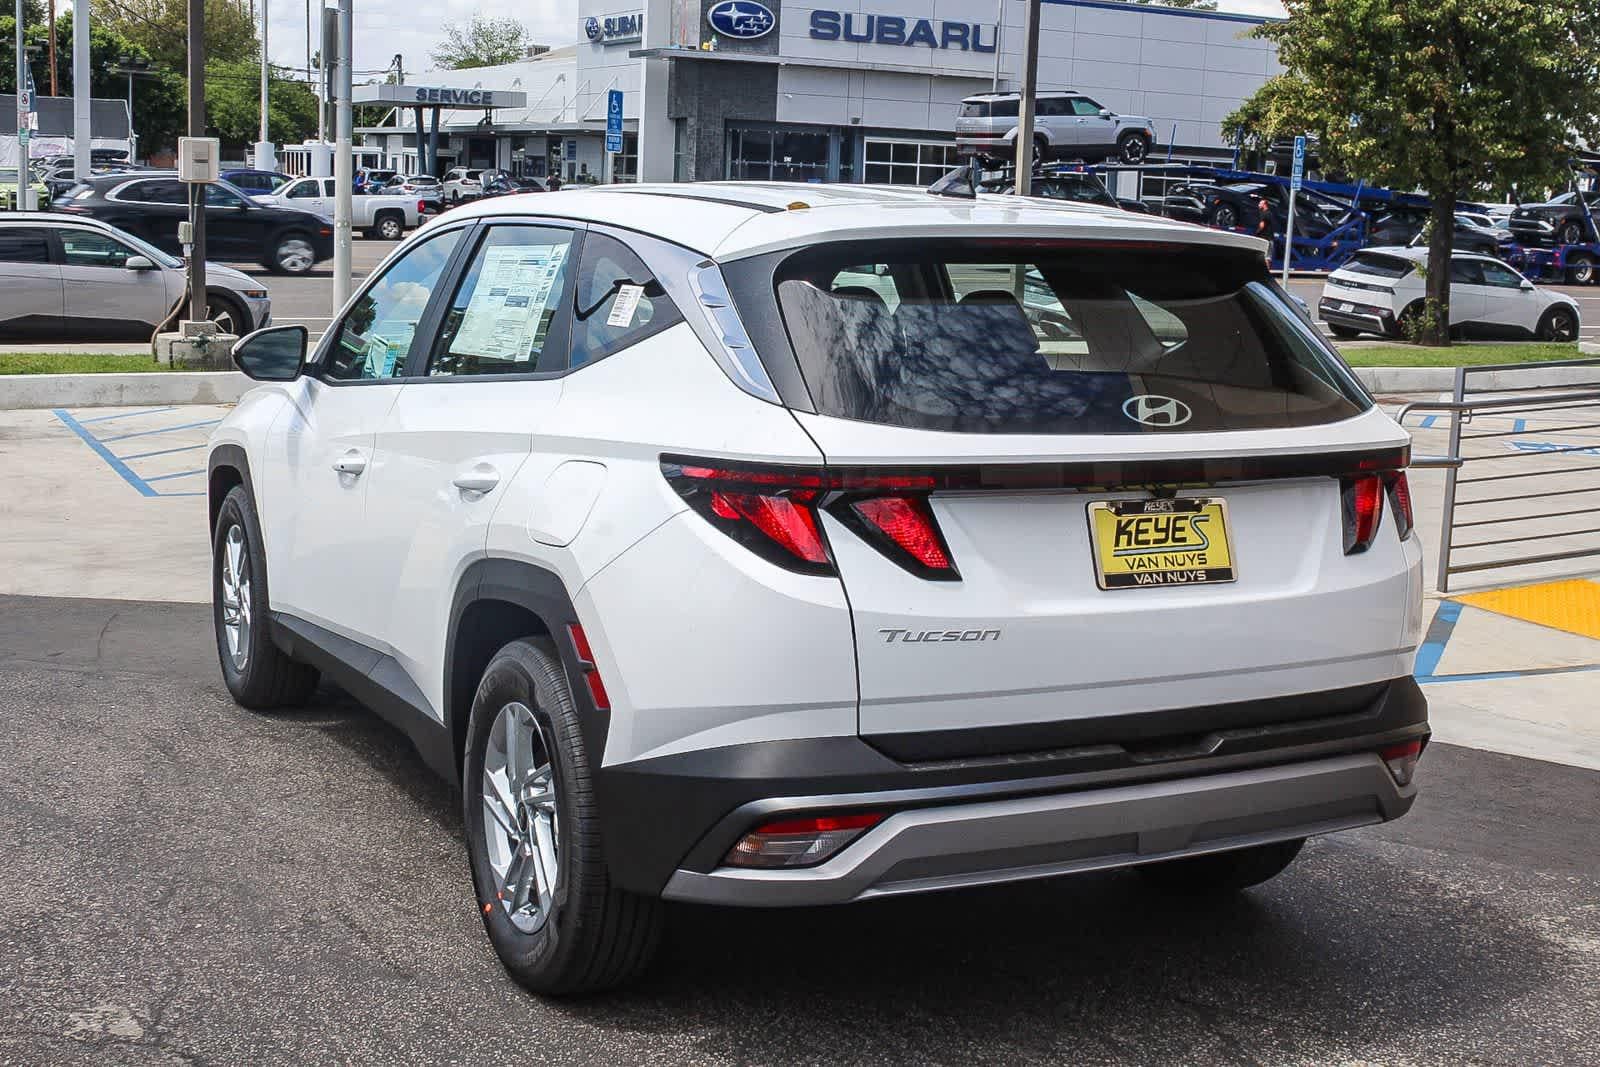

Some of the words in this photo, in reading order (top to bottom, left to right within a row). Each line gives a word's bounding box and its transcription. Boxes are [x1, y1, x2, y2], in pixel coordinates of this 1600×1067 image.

[809, 9, 998, 53] SUBARU
[416, 88, 492, 104] SERVICE
[1143, 500, 1175, 512] KEYES
[1113, 514, 1210, 554] KEYES
[1124, 557, 1159, 570] VAN
[1164, 553, 1207, 567] NUYS
[1134, 572, 1163, 585] VAN
[1167, 570, 1207, 582] NUYS
